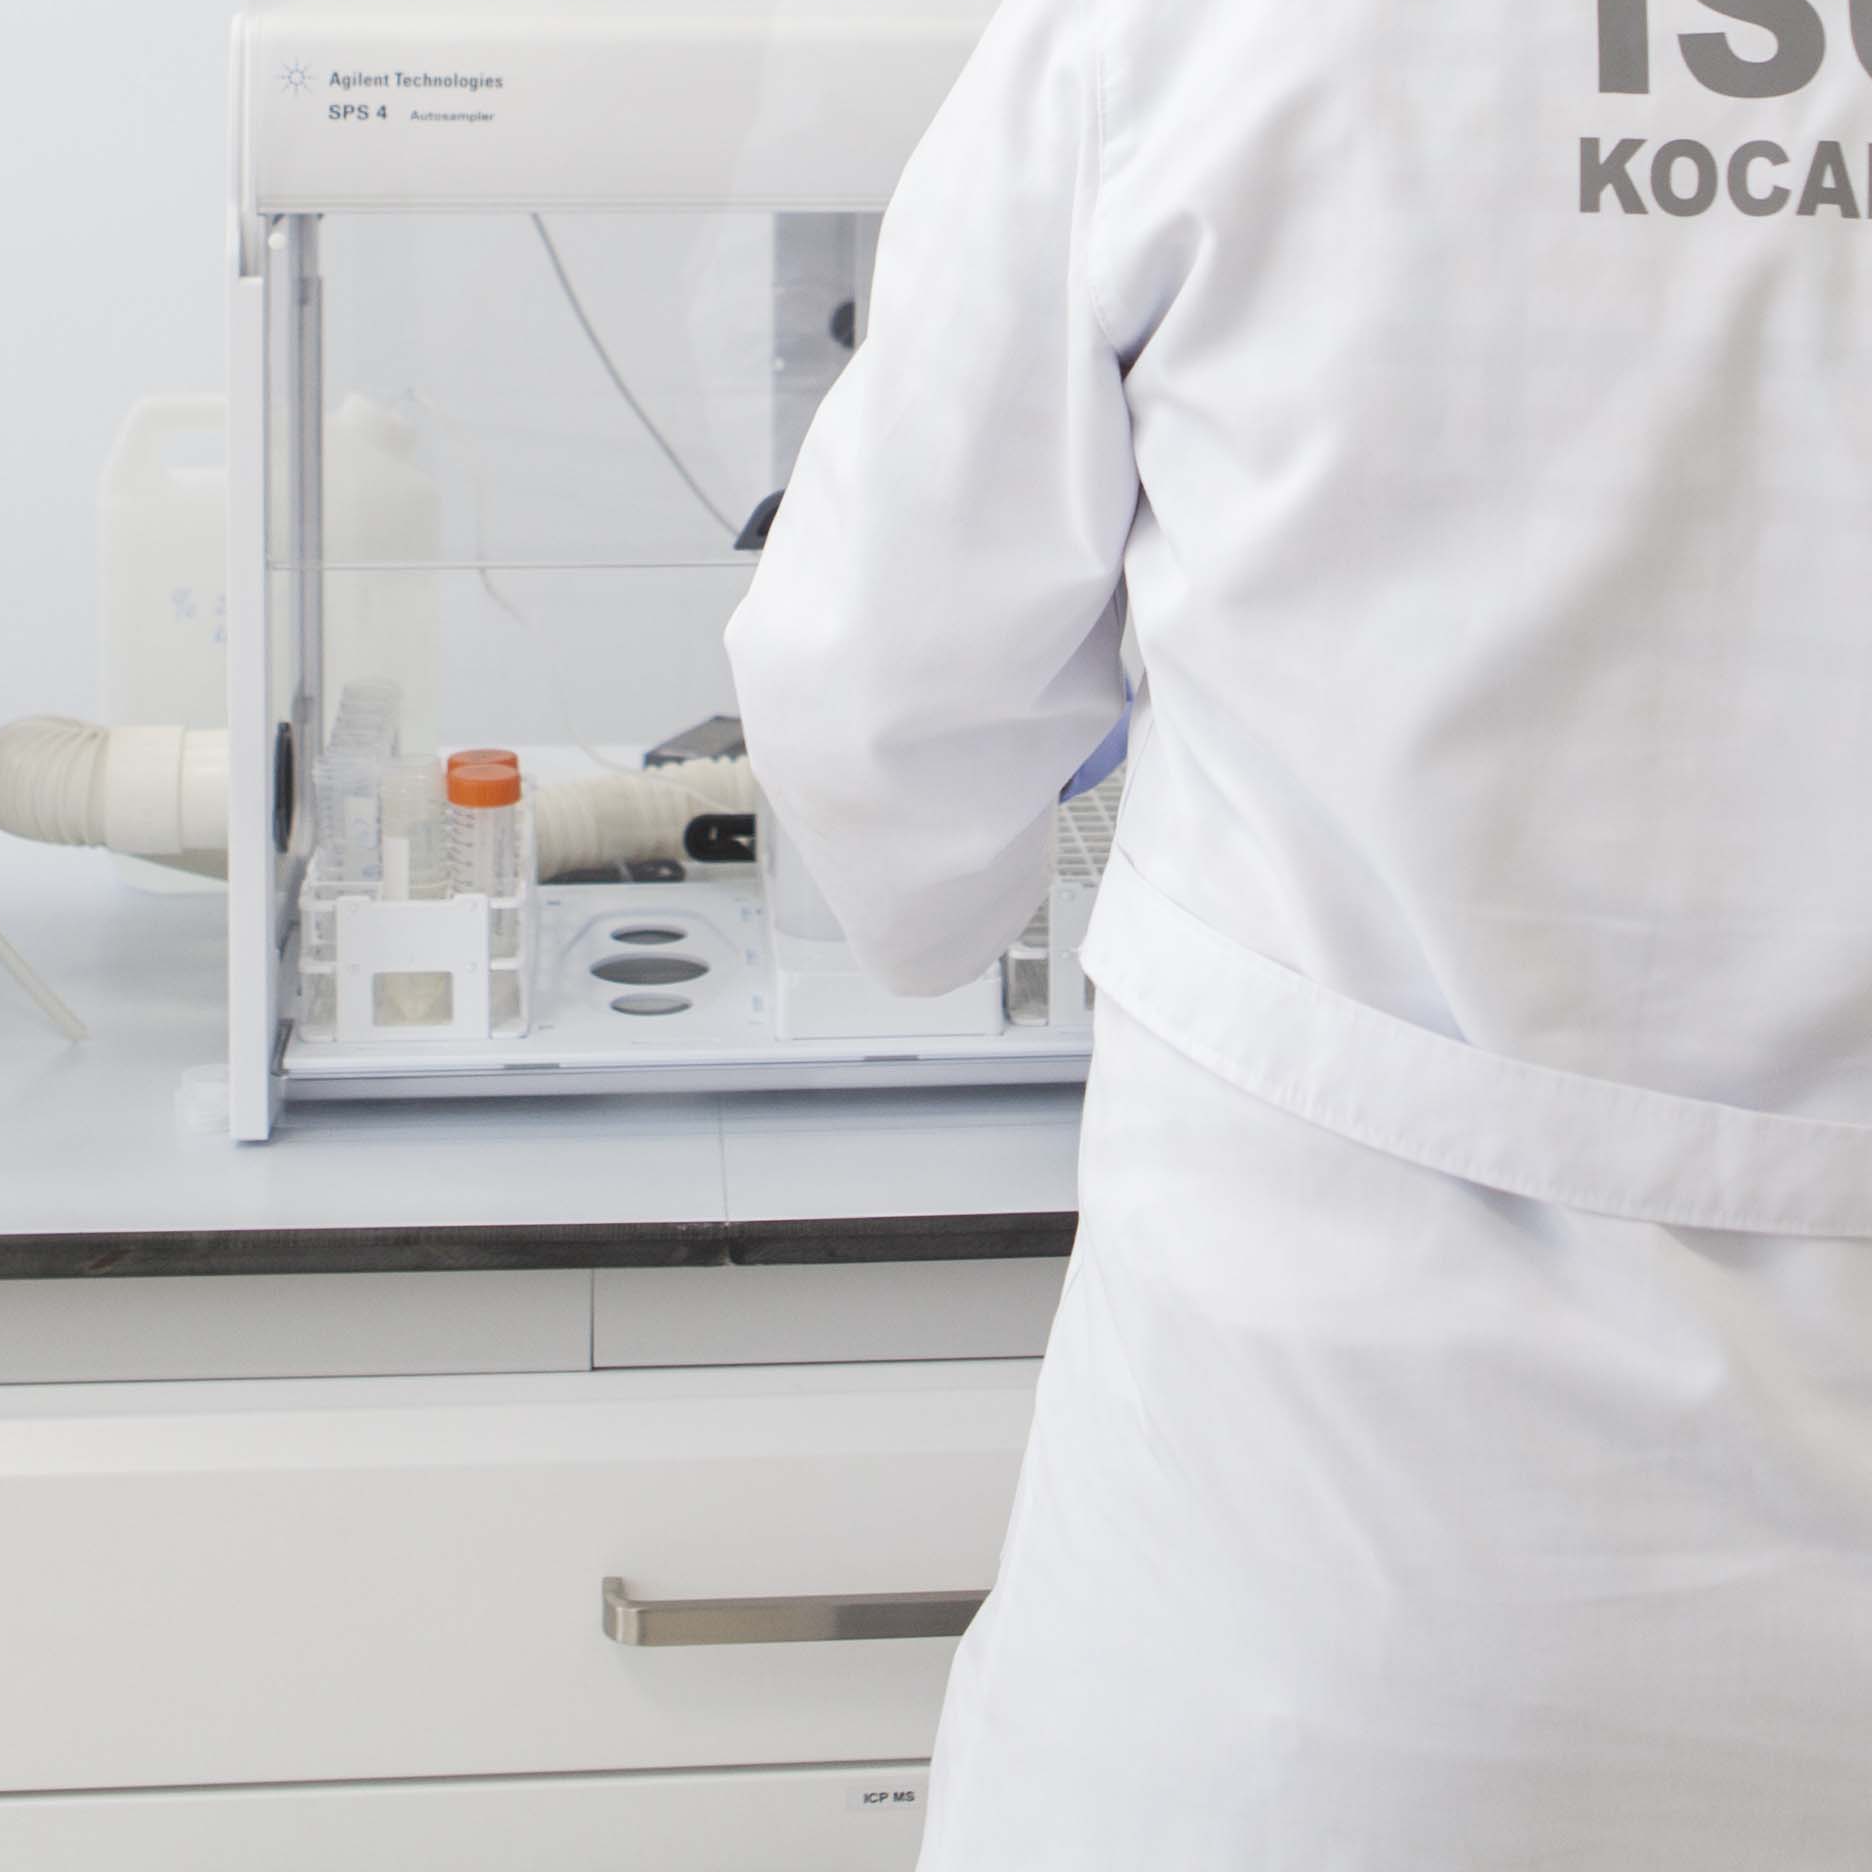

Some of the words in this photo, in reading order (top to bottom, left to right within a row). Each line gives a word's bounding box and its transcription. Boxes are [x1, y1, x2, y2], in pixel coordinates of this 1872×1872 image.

[329, 71, 390, 91] Agilent
[394, 72, 505, 92] Technologies
[328, 104, 369, 121] SPS
[376, 104, 387, 120] 4
[410, 110, 495, 124] Autosampler
[863, 1792, 889, 1804] ICP
[893, 1791, 914, 1803] MS
